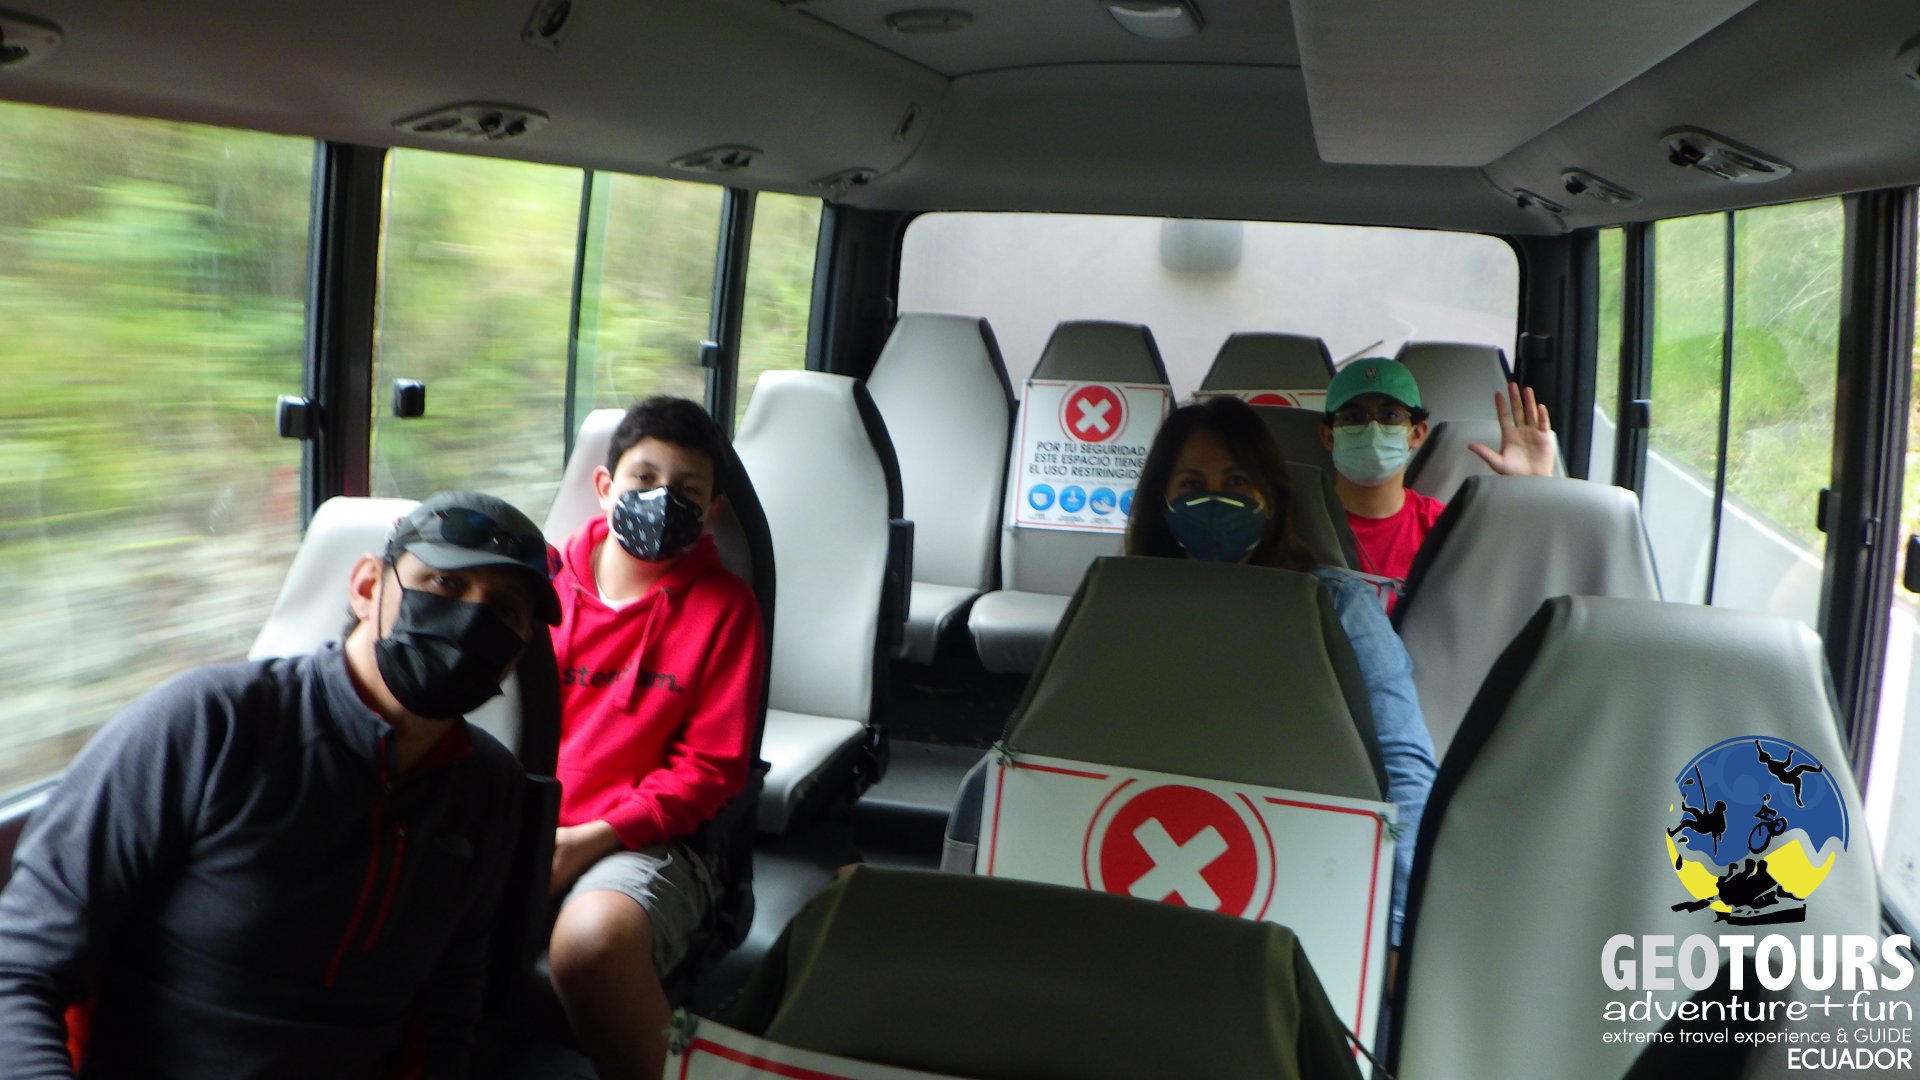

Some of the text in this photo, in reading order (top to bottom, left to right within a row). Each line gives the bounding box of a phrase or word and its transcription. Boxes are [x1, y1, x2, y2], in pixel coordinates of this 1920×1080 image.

[1036, 441, 1146, 456] POR TU SEGURIDAD
[1034, 452, 1145, 468] ESTE ESPACIO TIENE
[1029, 463, 1142, 479] EL USO RESTRINGID
